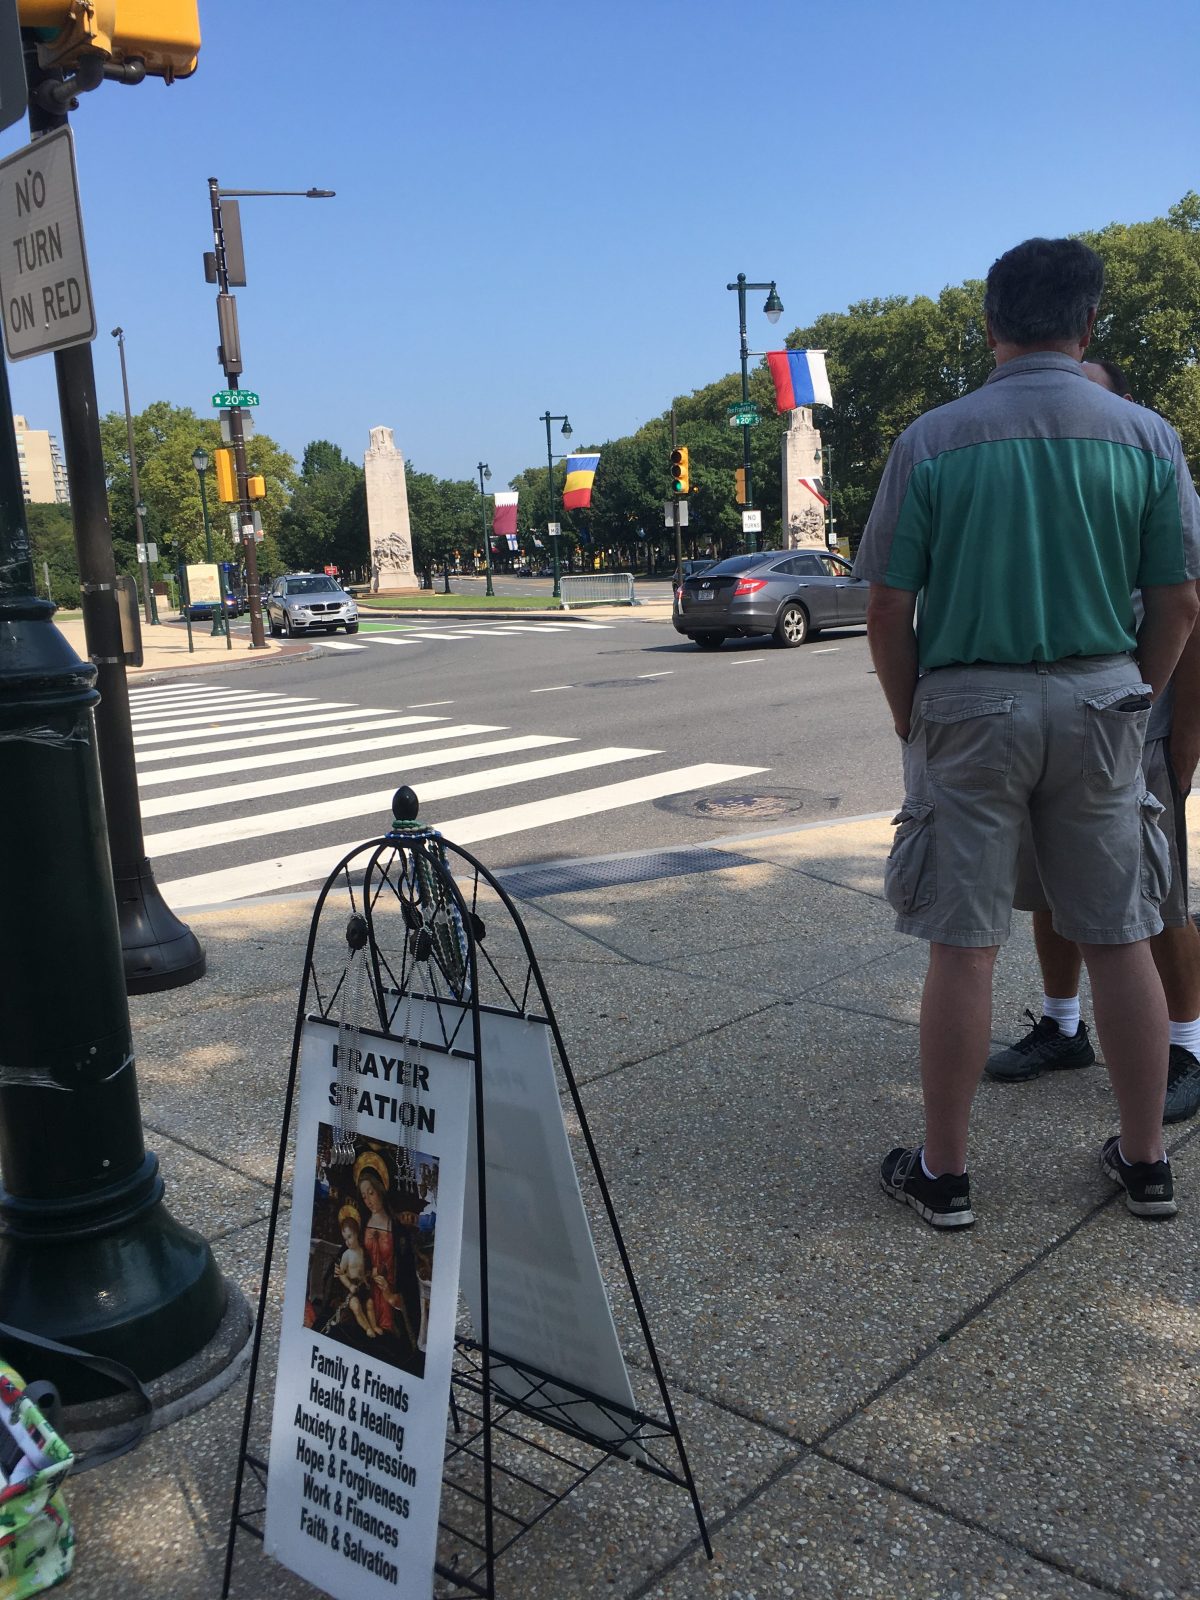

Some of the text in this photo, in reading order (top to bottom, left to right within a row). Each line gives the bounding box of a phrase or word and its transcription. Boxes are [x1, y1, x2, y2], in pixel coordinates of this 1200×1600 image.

[15, 171, 46, 217] NO
[13, 222, 63, 274] TURN
[10, 277, 81, 333] ON RED
[225, 395, 257, 404] 20th St
[328, 1081, 436, 1134] STATION
[1145, 1184, 1165, 1195] NIKE
[311, 1345, 409, 1413] Family & Friends
[294, 1403, 417, 1488] Anxiety & Depression
[309, 1377, 405, 1452] Health & Healing
[296, 1436, 410, 1519] Hope & Forgiveness
[303, 1473, 399, 1548] Work & Finances
[300, 1507, 398, 1585] Faith & Salvation
